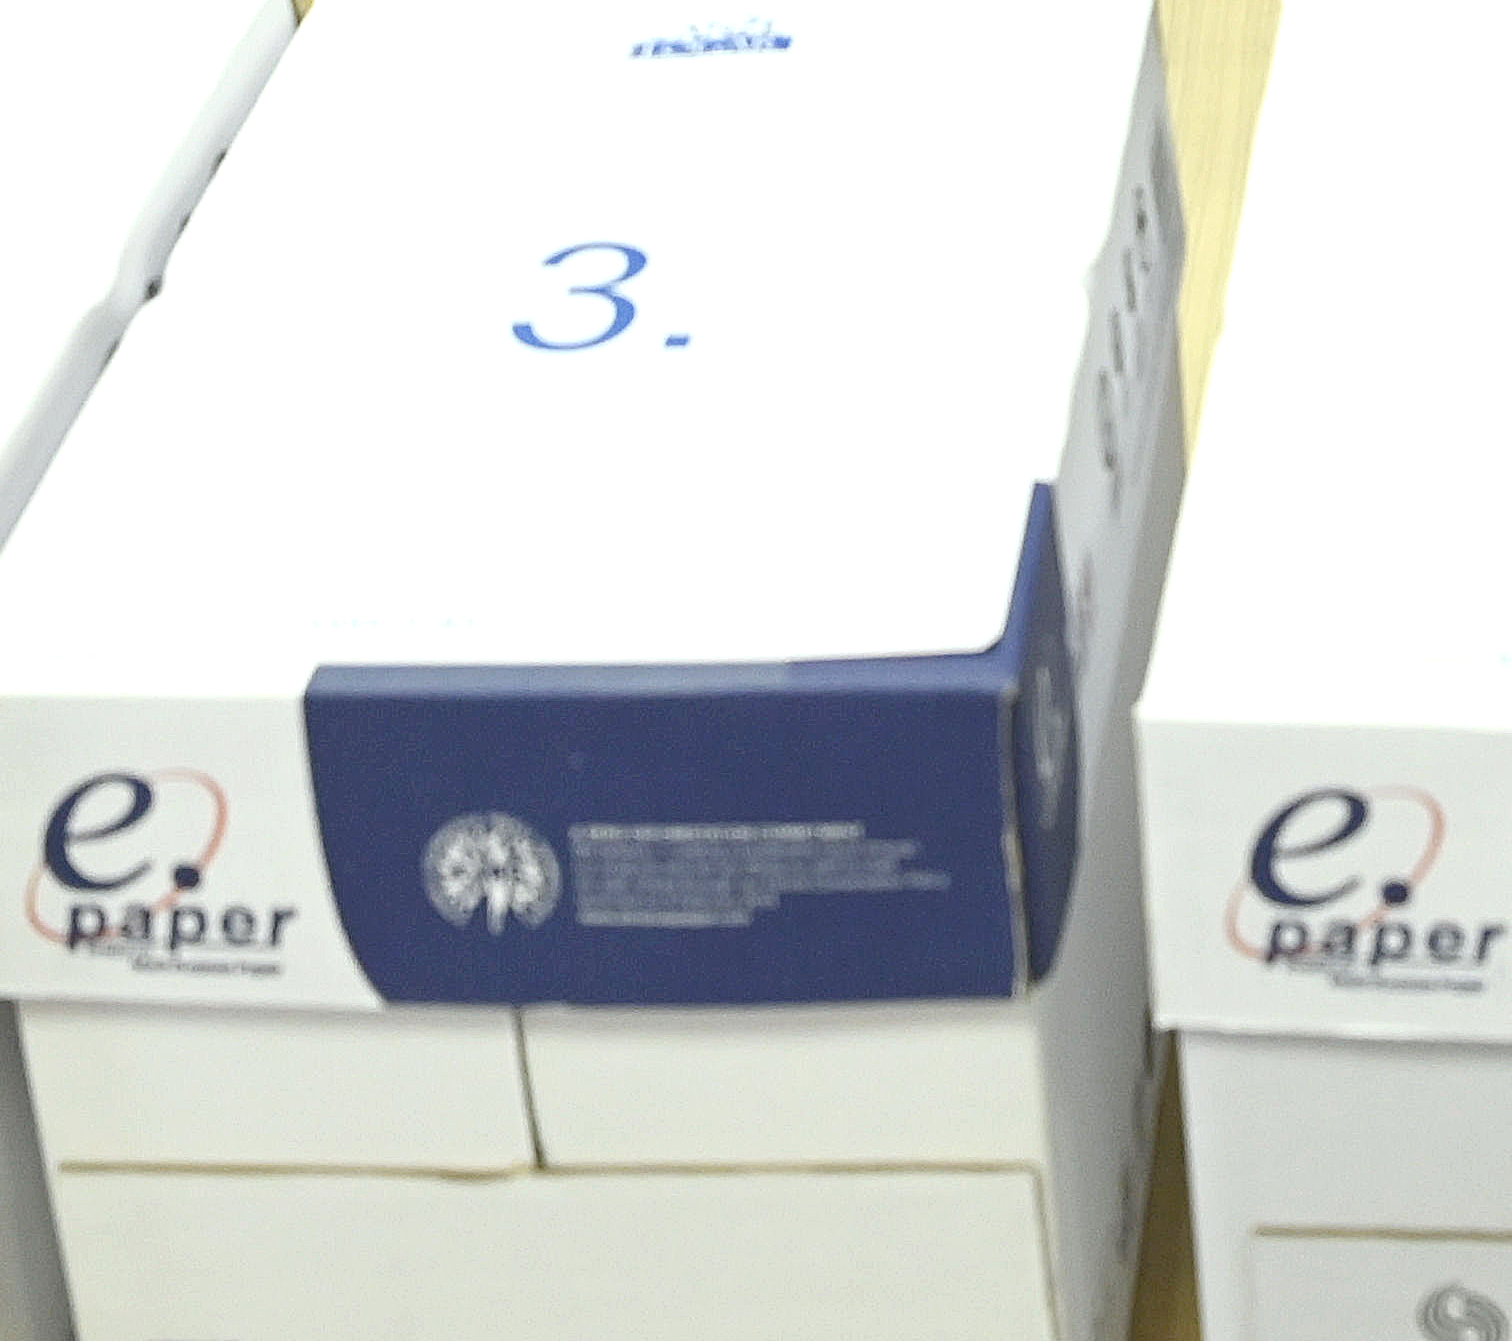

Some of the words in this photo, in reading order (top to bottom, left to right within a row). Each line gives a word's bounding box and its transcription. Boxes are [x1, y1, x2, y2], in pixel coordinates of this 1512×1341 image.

[510, 241, 693, 353] 3.
[61, 902, 296, 955] paper
[1261, 917, 1505, 971] paper
